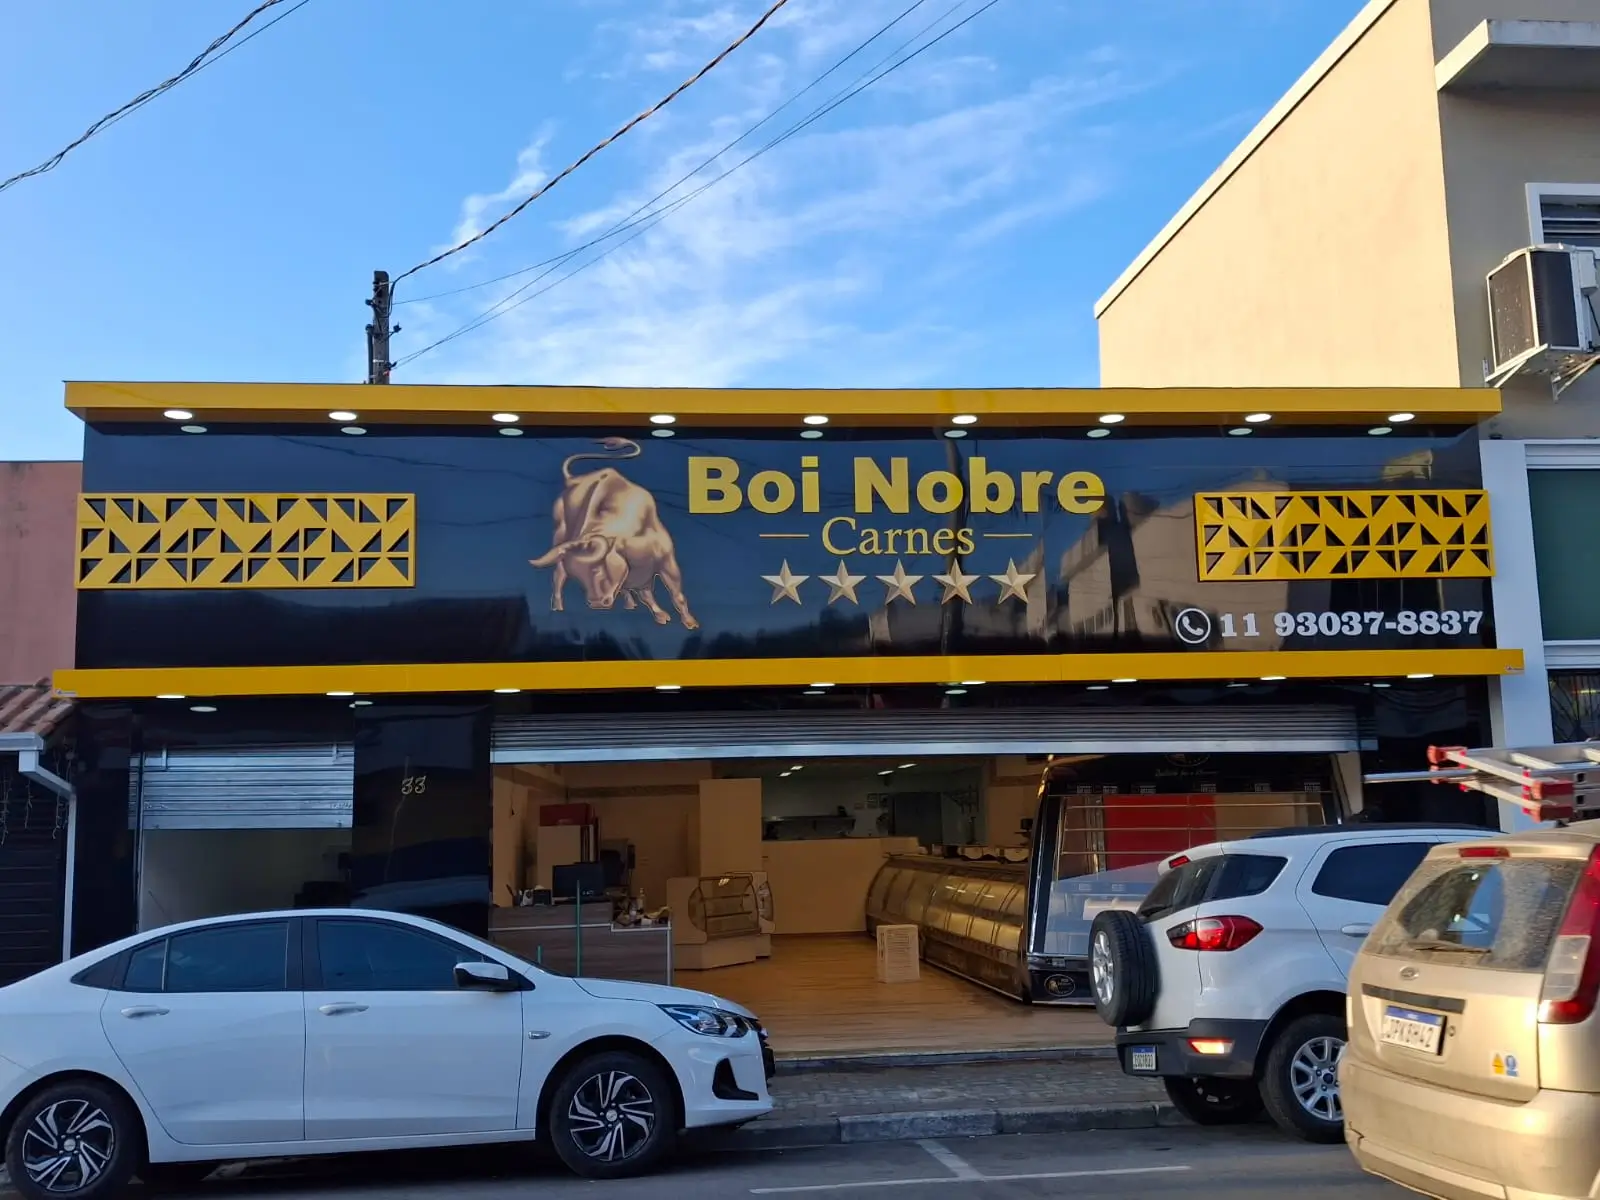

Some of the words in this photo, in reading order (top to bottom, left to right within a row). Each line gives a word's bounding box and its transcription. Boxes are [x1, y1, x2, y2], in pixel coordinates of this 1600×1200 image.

[688, 456, 820, 514] Boi
[853, 456, 1105, 514] Nobre
[821, 516, 975, 556] Carnes
[1220, 612, 1260, 637] 11
[1274, 610, 1483, 636] 93037-8837
[401, 775, 427, 795] 33
